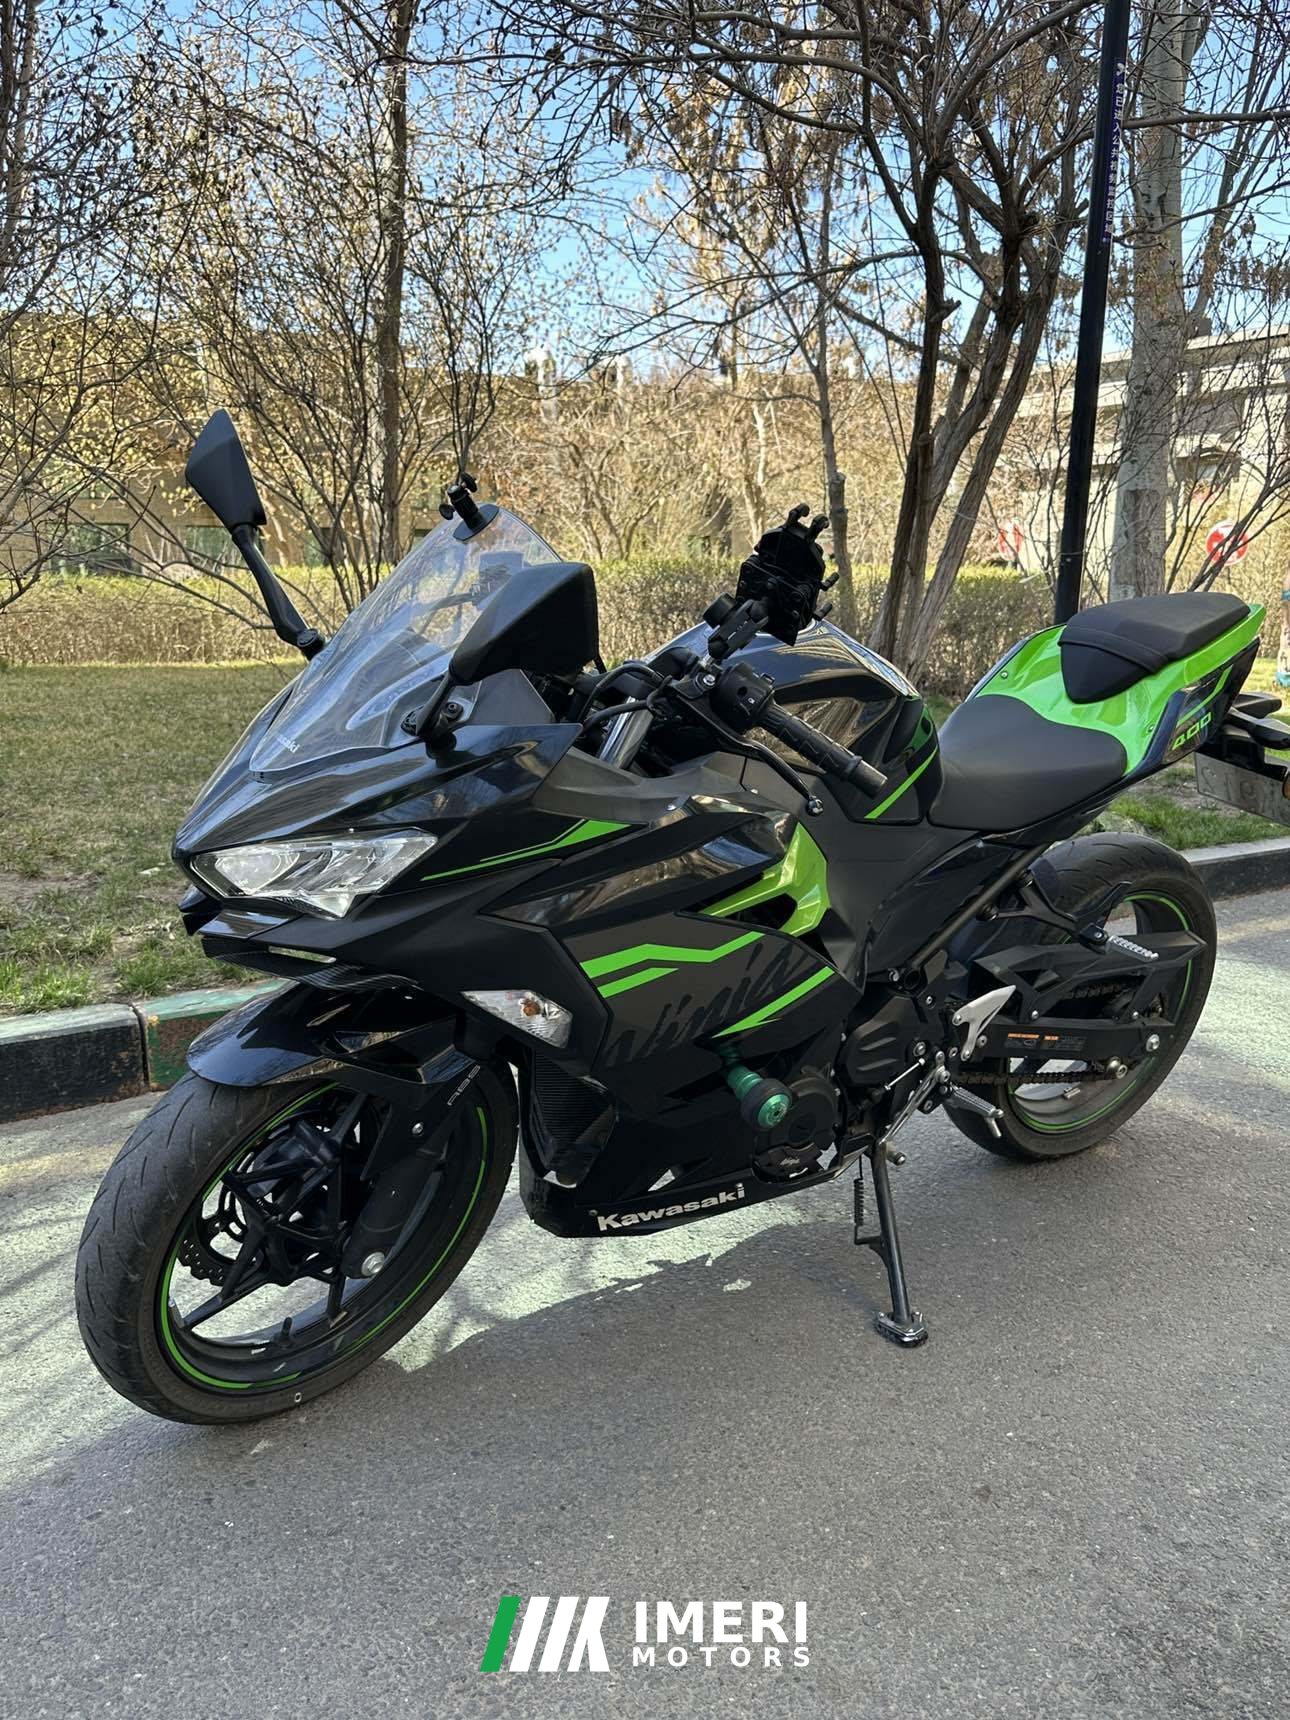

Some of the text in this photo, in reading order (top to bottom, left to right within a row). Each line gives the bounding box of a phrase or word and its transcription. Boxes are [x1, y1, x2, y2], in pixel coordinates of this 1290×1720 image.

[1172, 711, 1212, 751] 400
[604, 942, 822, 1067] Ninja
[447, 1064, 481, 1106] ABS
[597, 1182, 745, 1231] Kawasaki
